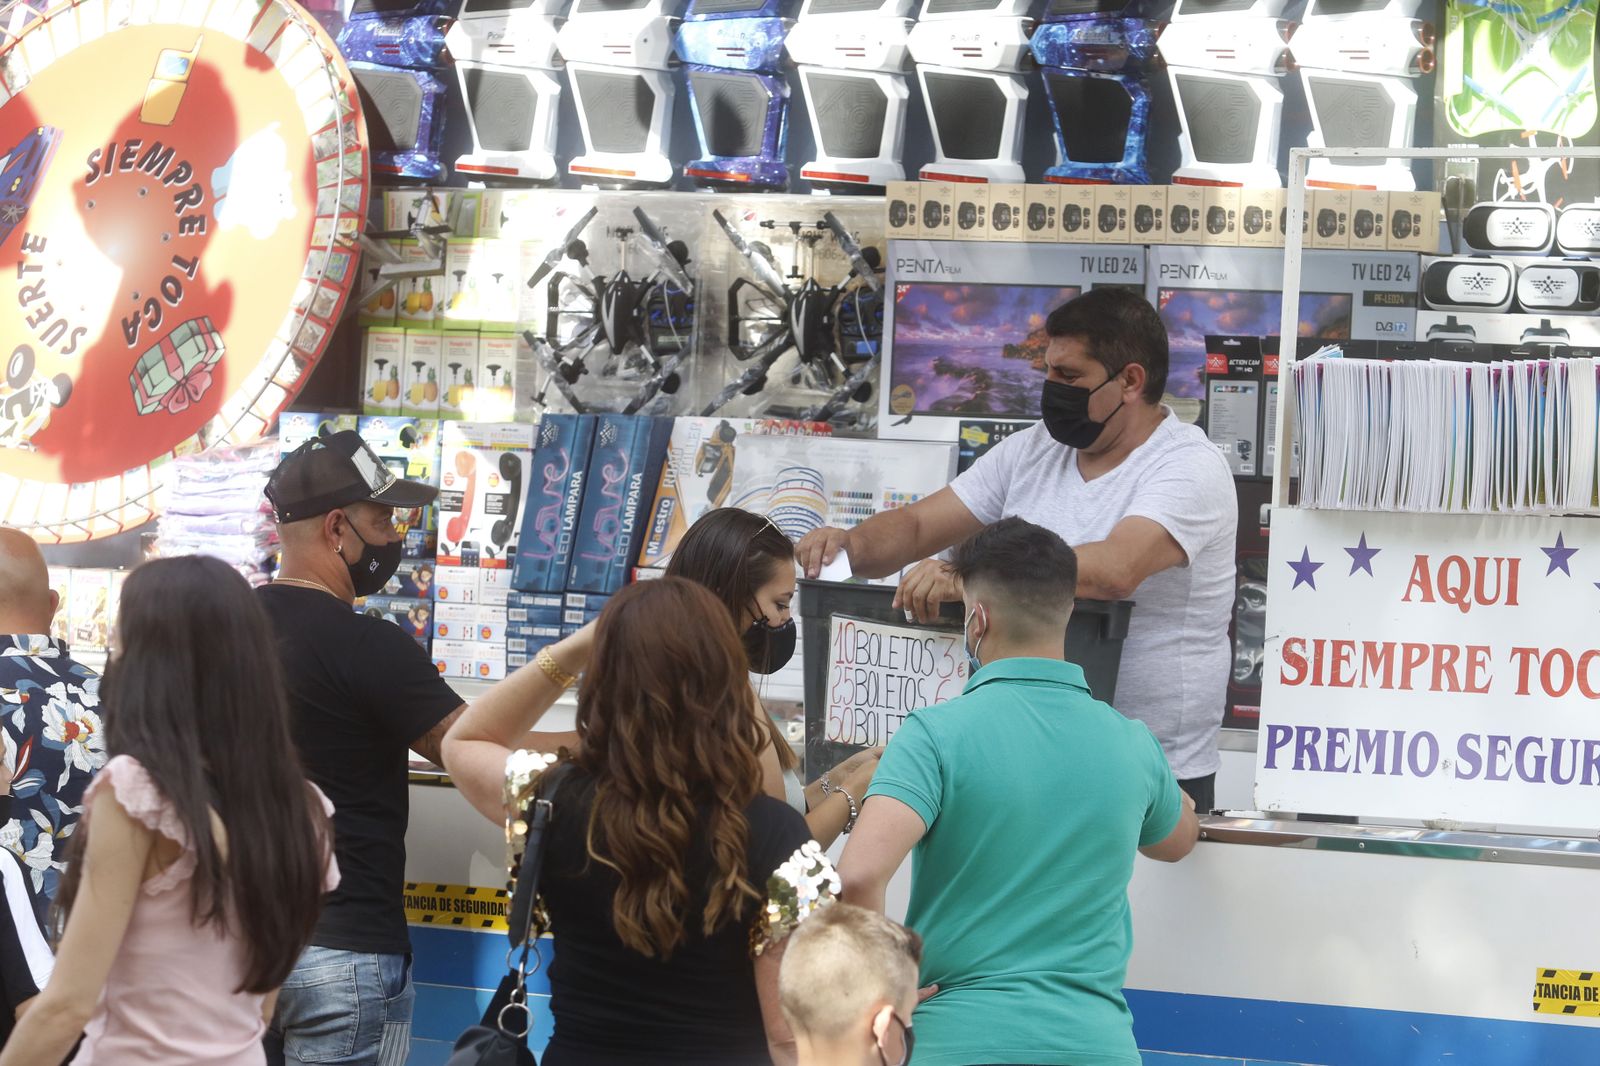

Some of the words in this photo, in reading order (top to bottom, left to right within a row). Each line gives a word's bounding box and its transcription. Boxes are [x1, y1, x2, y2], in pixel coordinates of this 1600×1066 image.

[85, 139, 206, 236] SIEMPRE
[896, 258, 945, 274] PENTA
[1080, 256, 1095, 273] TV
[1098, 256, 1119, 274] LED
[1122, 257, 1138, 274] 24
[1160, 264, 1210, 280] PENTA
[1352, 263, 1367, 281] TV
[1370, 264, 1392, 281] LED
[1395, 264, 1411, 282] 24
[17, 232, 87, 355] SUERTE
[121, 254, 199, 347] TOCA
[1375, 321, 1393, 332] DVB
[562, 471, 583, 532] LAMPARA
[622, 472, 643, 533] LAMPARA
[556, 532, 571, 565] LED
[647, 499, 671, 555] Maestro
[614, 534, 631, 569] LED
[1400, 554, 1522, 613] AQUI
[834, 621, 856, 664] 10
[855, 630, 935, 676] BOLETOS
[1279, 636, 1494, 694] SIEMPRE
[1509, 647, 1600, 700] TOC
[832, 665, 855, 706] 25
[855, 668, 927, 710] BOLETOS
[828, 704, 854, 745] 50
[1263, 723, 1440, 778] PREMIO
[1455, 733, 1600, 786] SEGUR
[439, 897, 452, 911] DE
[1584, 987, 1599, 1002] DE
